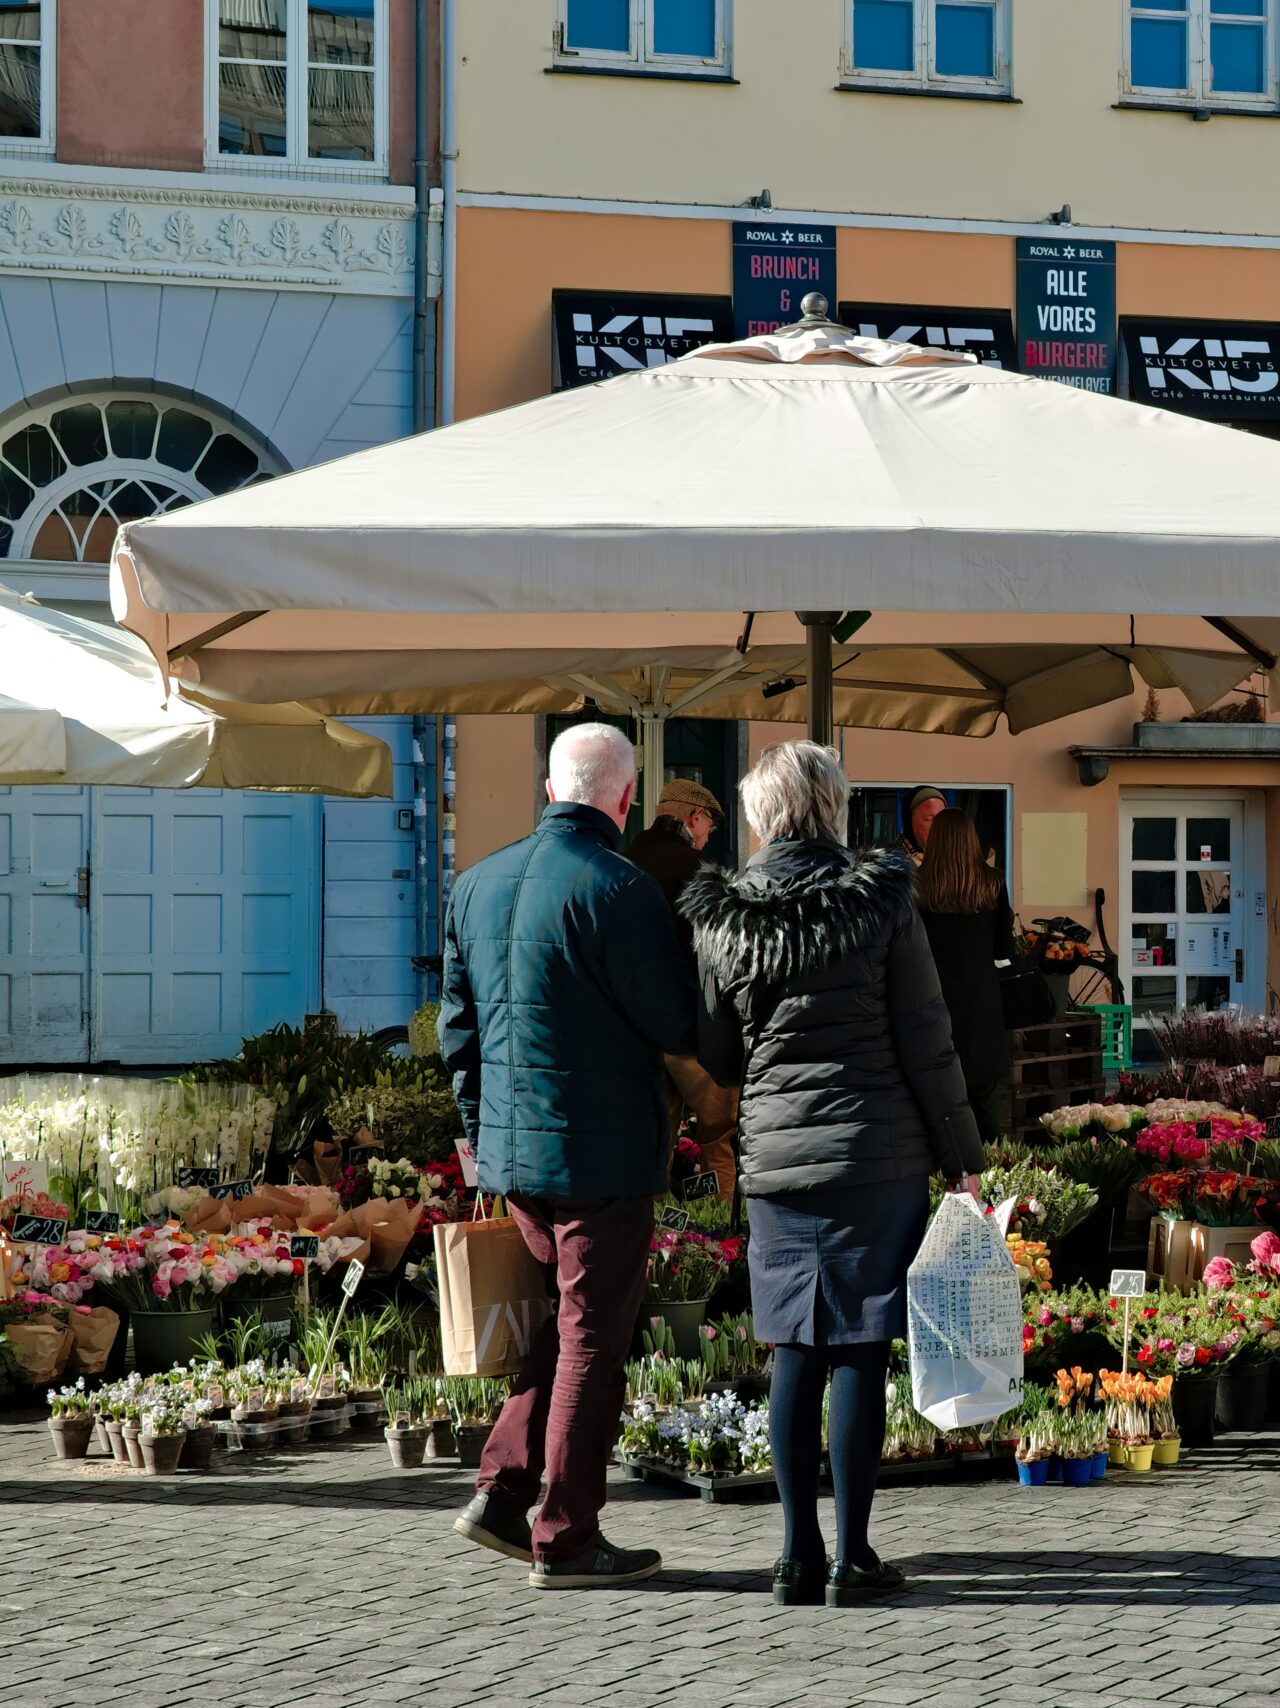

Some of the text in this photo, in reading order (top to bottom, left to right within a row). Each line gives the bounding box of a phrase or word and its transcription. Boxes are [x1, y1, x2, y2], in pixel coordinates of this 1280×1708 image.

[746, 231, 823, 243] ROYAL BEER
[1030, 246, 1104, 259] ROYAL BEER
[751, 255, 820, 280] BRUNCH
[1046, 269, 1087, 297] ALLE
[780, 289, 791, 312] &
[1037, 305, 1096, 333] VORES
[1025, 340, 1108, 368] BURGERE
[1144, 357, 1275, 371] KULTORVET15
[1151, 389, 1184, 399] Café
[37, 1220, 63, 1244] 28
